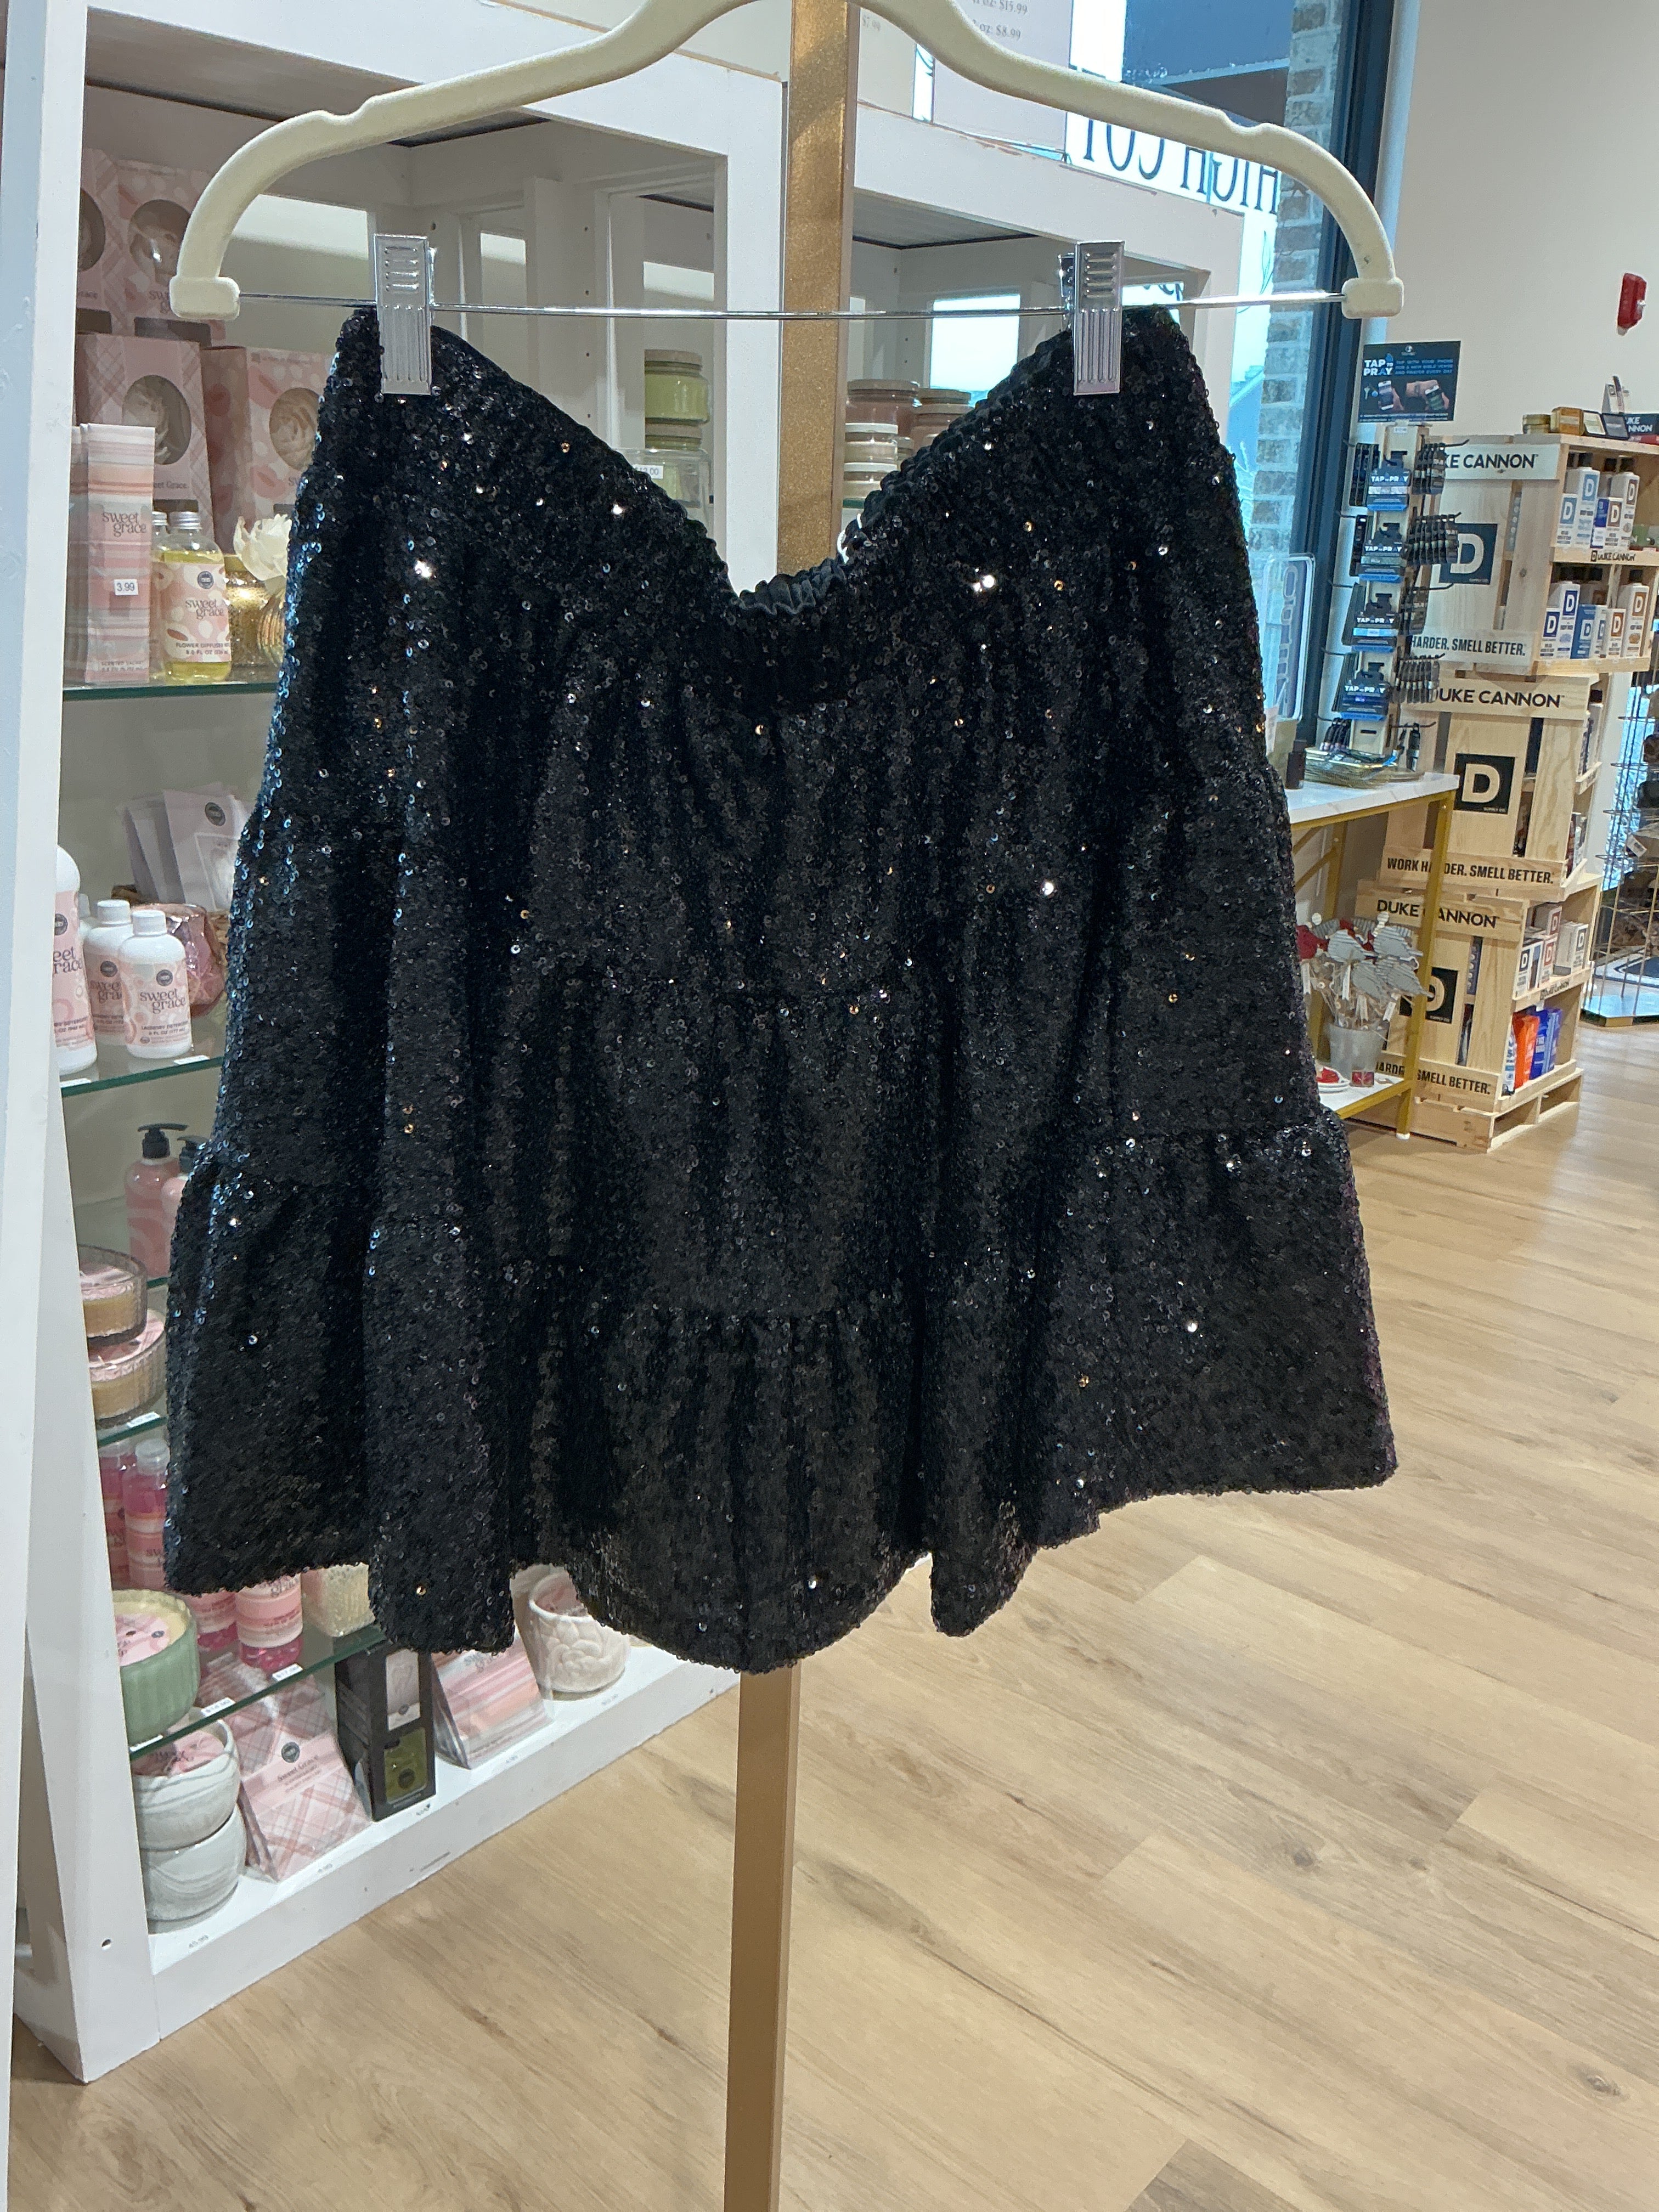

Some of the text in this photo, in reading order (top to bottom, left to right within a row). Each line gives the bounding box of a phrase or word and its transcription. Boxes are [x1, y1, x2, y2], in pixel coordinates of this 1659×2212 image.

[1364, 359, 1386, 368] TAP
[1363, 367, 1393, 376] PRAY
[1628, 424, 1653, 432] NNON
[1463, 454, 1536, 469] CANNON
[101, 512, 139, 523] sweet
[113, 521, 146, 538] grace
[1449, 533, 1485, 574] D
[116, 582, 135, 591] 3.99
[185, 599, 217, 608] sweet
[196, 606, 224, 620] grace
[1452, 638, 1482, 653] SMELL
[1485, 641, 1526, 656] BETTER.
[1364, 686, 1386, 694] PRAY
[1478, 690, 1561, 708] CANNON
[1462, 763, 1501, 804] D
[1387, 857, 1419, 872] WORK
[1469, 865, 1505, 879] SMELL
[1508, 868, 1554, 884] BETTER.
[1376, 899, 1497, 929] DUKE ANNON
[53, 946, 76, 962] eet
[140, 988, 178, 1002] sweet
[152, 997, 186, 1014] grace
[1417, 1069, 1446, 1086] SMELL
[1449, 1076, 1491, 1095] BETTER.
